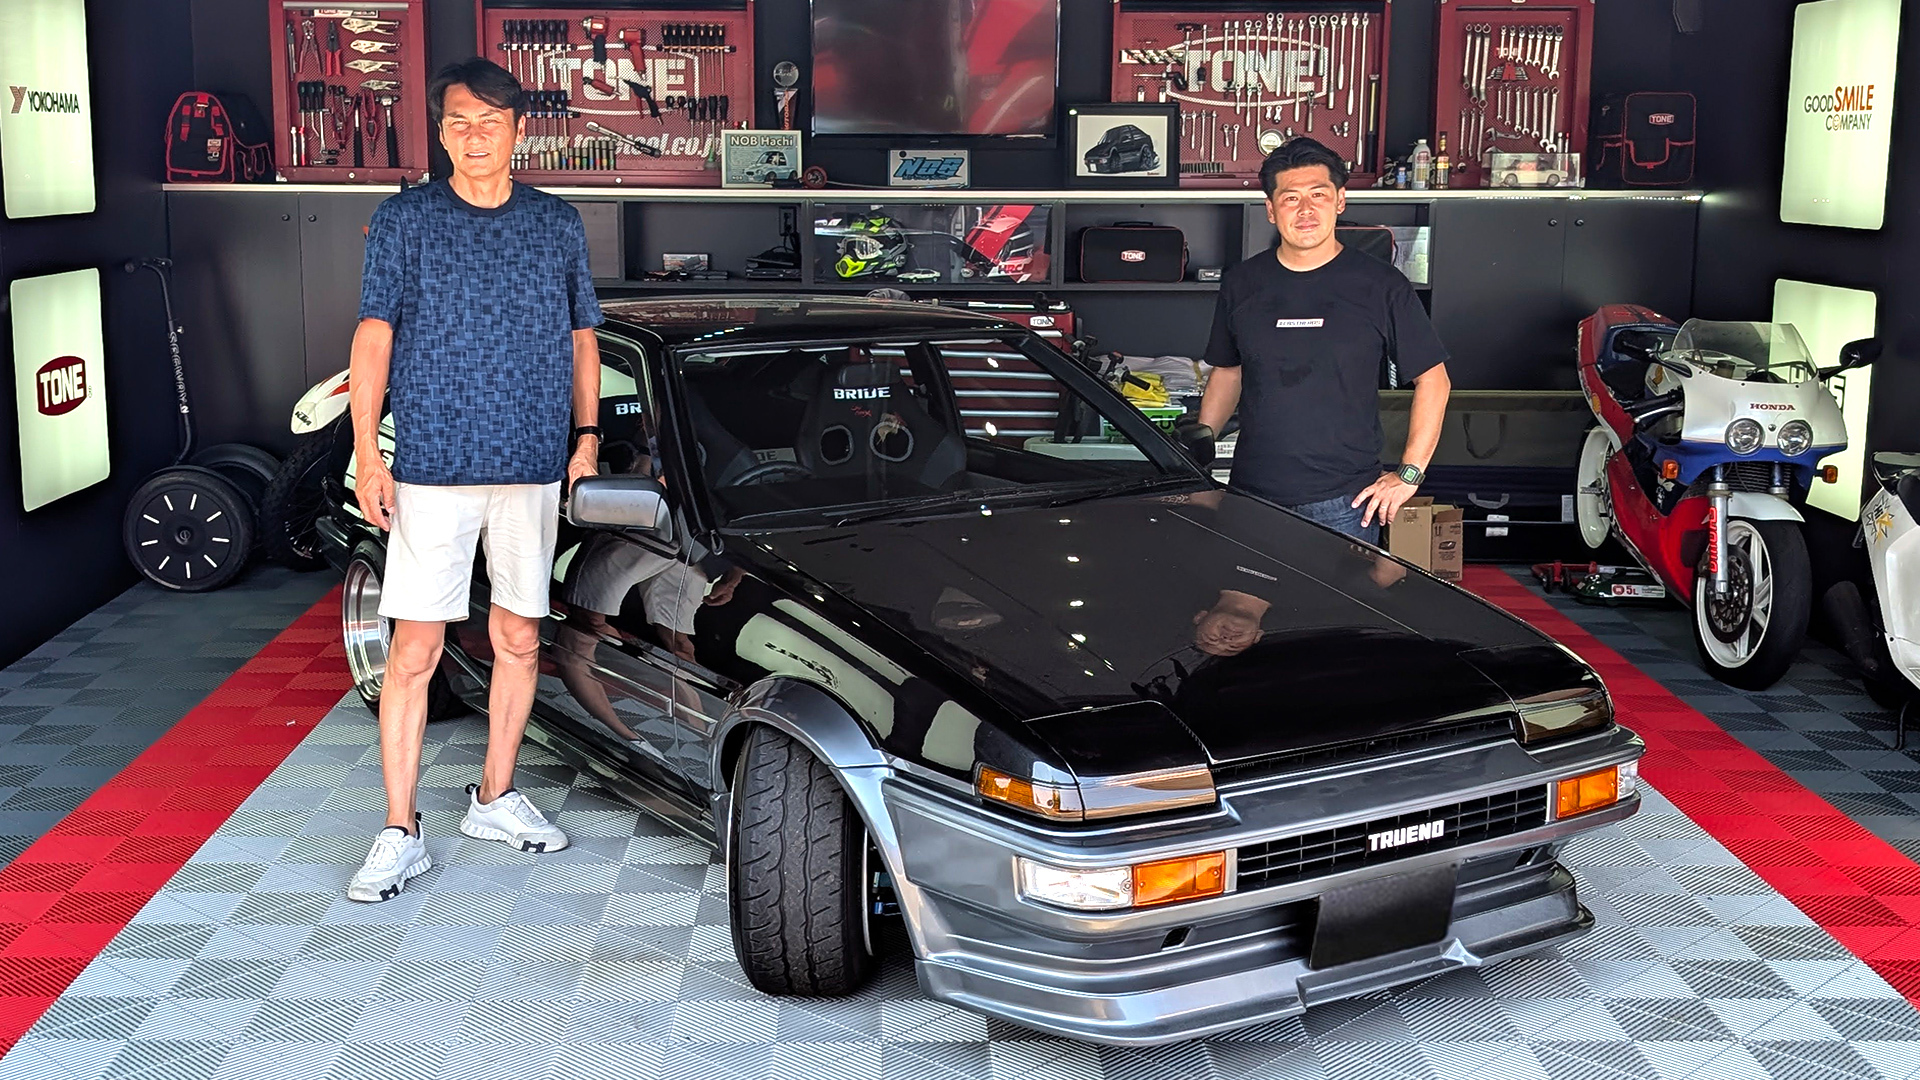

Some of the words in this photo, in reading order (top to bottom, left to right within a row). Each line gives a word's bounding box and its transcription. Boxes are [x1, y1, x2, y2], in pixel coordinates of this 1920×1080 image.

[549, 57, 688, 101] TONE
[1180, 50, 1316, 92] TONE
[27, 90, 80, 113] YOKOHAMA
[1804, 95, 1834, 113] GOOD
[1834, 84, 1874, 112] SMILE
[1651, 115, 1672, 123] TONE
[1826, 114, 1872, 131] COMPANY
[731, 136, 758, 146] NOB
[761, 136, 793, 146] Hachi
[1124, 251, 1143, 259] TONE
[40, 363, 84, 408] TONE
[833, 386, 891, 399] BRIDE
[1750, 403, 1796, 411] HONDA
[1367, 820, 1445, 851] TRUENO
